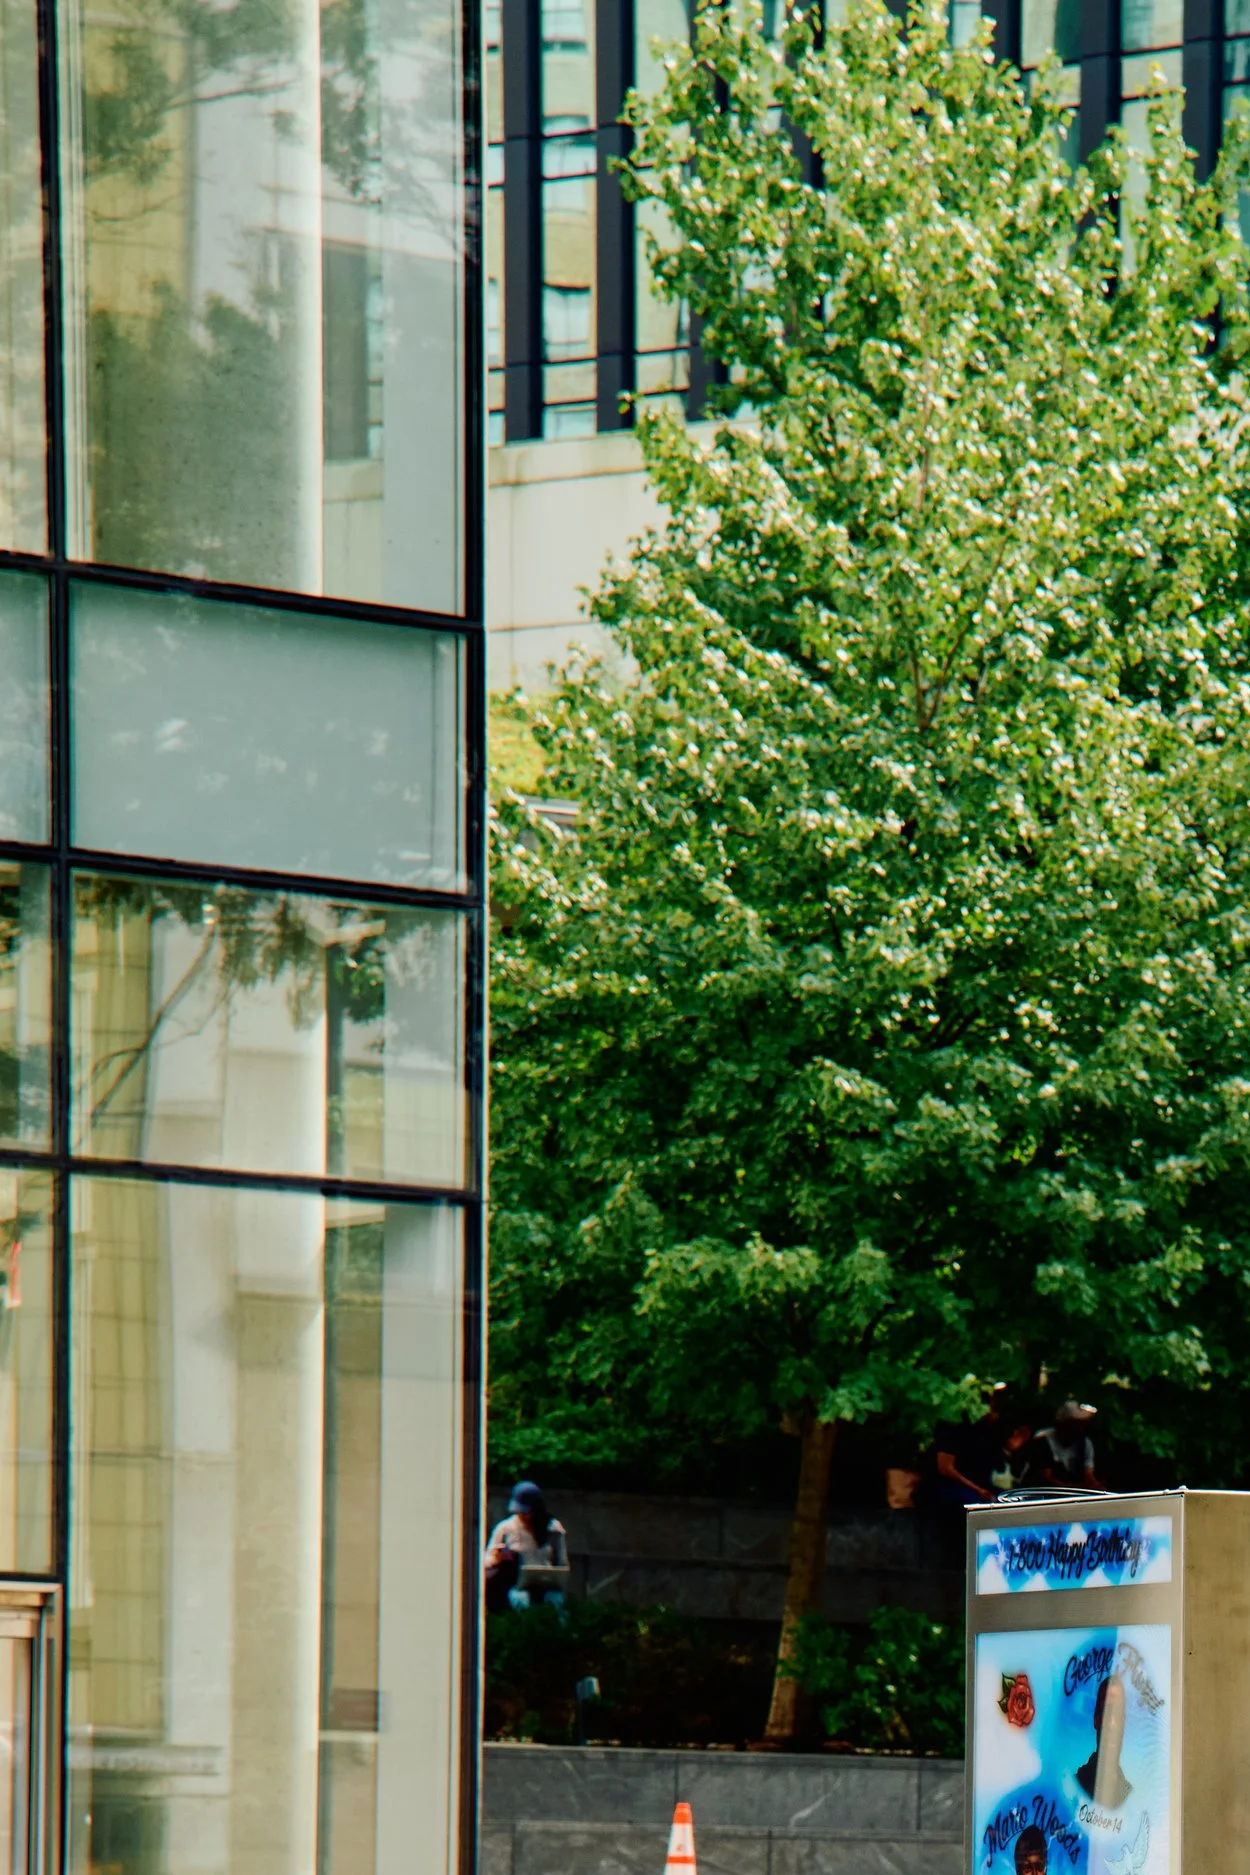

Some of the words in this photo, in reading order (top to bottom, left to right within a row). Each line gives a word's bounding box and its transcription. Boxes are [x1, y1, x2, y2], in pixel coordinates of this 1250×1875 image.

[1008, 1539, 1044, 1571] 1-800
[1047, 1529, 1087, 1580] Happy
[1063, 1647, 1115, 1697] George
[982, 1801, 1029, 1868] Mario
[1032, 1794, 1081, 1865] Woods
[1079, 1803, 1112, 1831] October
[1112, 1818, 1123, 1834] 14
